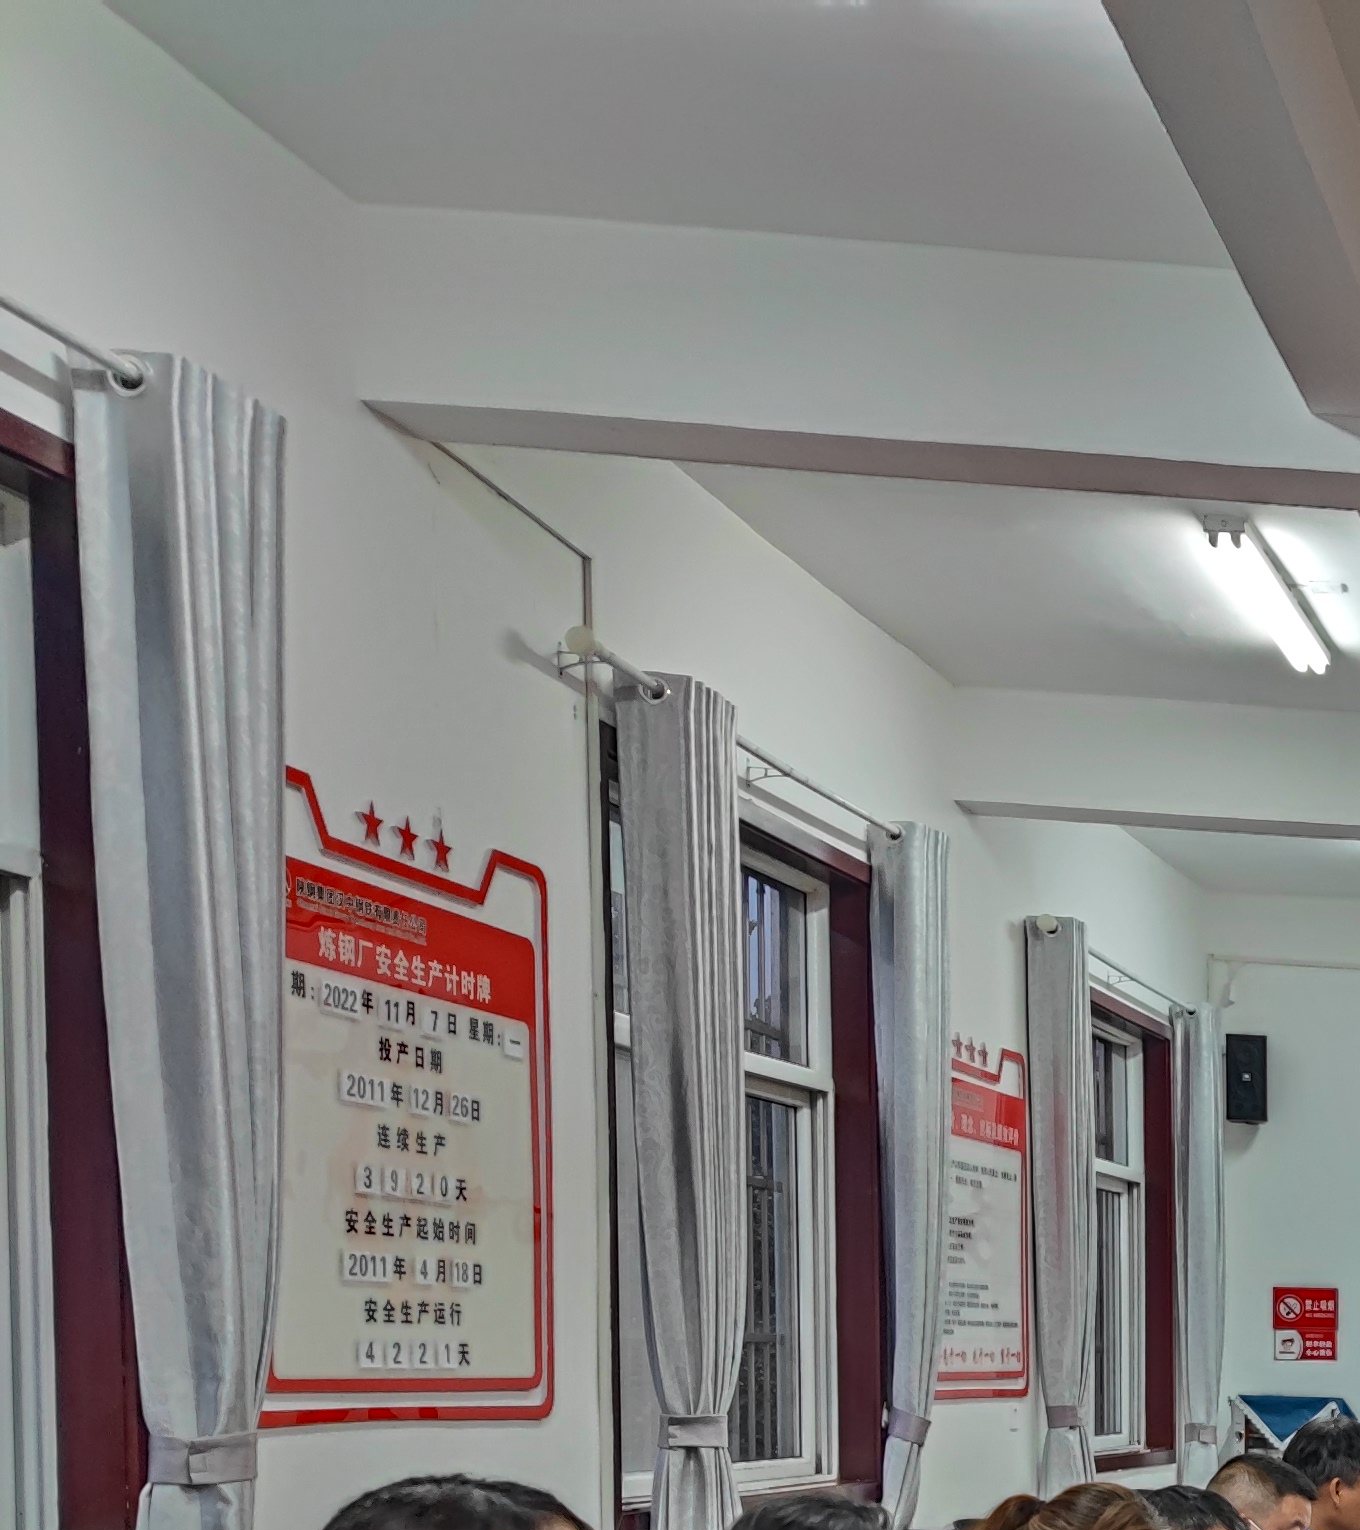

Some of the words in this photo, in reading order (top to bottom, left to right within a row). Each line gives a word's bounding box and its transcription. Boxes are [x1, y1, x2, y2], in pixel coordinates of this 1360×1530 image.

[317, 925, 492, 1005] 炼钢厂安全生产计时牌
[378, 1036, 443, 1074] 投产日期
[345, 1073, 481, 1122] 2011年12月26日
[377, 1123, 447, 1156] 连续生产
[362, 1165, 467, 1202] 3920天
[345, 1208, 477, 1245] 安全生产起始时间
[348, 1253, 483, 1286] 2011年4月18日
[364, 1298, 462, 1327] 安全生产运行
[365, 1341, 471, 1367] 4221天
